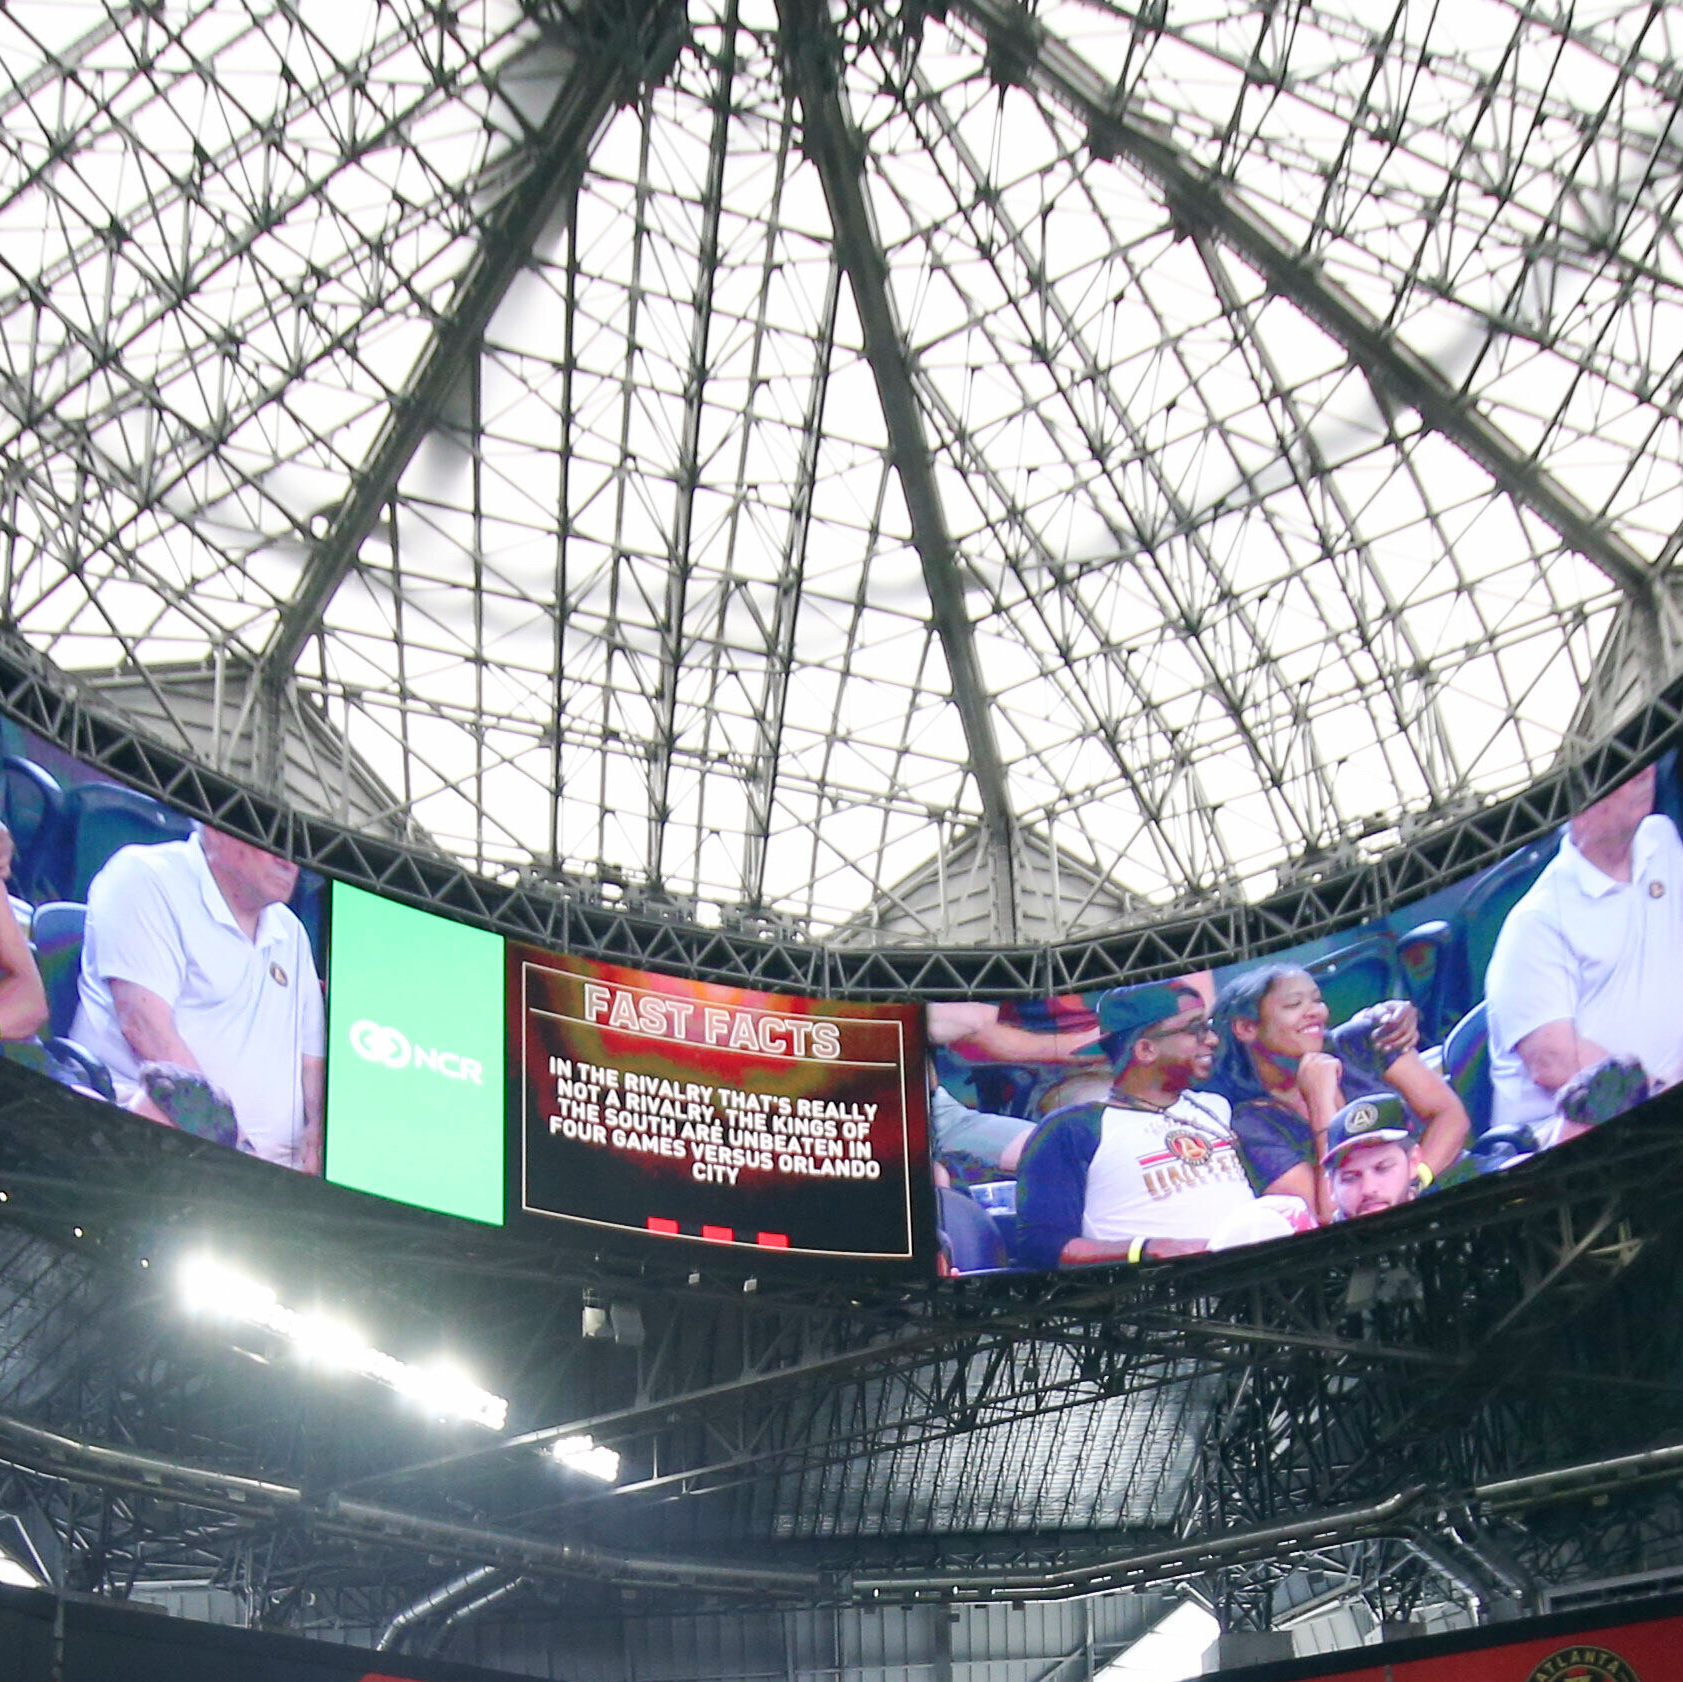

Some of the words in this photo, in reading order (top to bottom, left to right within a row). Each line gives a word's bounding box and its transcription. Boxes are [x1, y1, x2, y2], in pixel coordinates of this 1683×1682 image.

[584, 983, 694, 1039] FAST
[704, 1007, 841, 1059] FACTS
[414, 1047, 483, 1084] NCR
[549, 1056, 572, 1078] IN
[577, 1062, 620, 1088] THE
[624, 1072, 714, 1104] RIVALRY
[718, 1087, 793, 1115] THAT'S
[797, 1098, 879, 1121] REALLY
[557, 1078, 600, 1103] NOT
[605, 1089, 621, 1108] A
[625, 1092, 721, 1127] RIVALRY,
[725, 1109, 768, 1132] THE
[772, 1115, 838, 1139] KINGS
[842, 1122, 871, 1140] OF
[557, 1097, 600, 1123] THE
[604, 1107, 676, 1138] SOUTH
[680, 1122, 724, 1145] ARE
[728, 1128, 844, 1157] UNBEATEN
[848, 1141, 872, 1159] IN
[548, 1115, 608, 1144] FOUR
[612, 1129, 686, 1158] GAMES
[691, 1142, 774, 1171] VERSUS
[778, 1154, 881, 1180] ORLANDO
[692, 1161, 741, 1185] CITY
